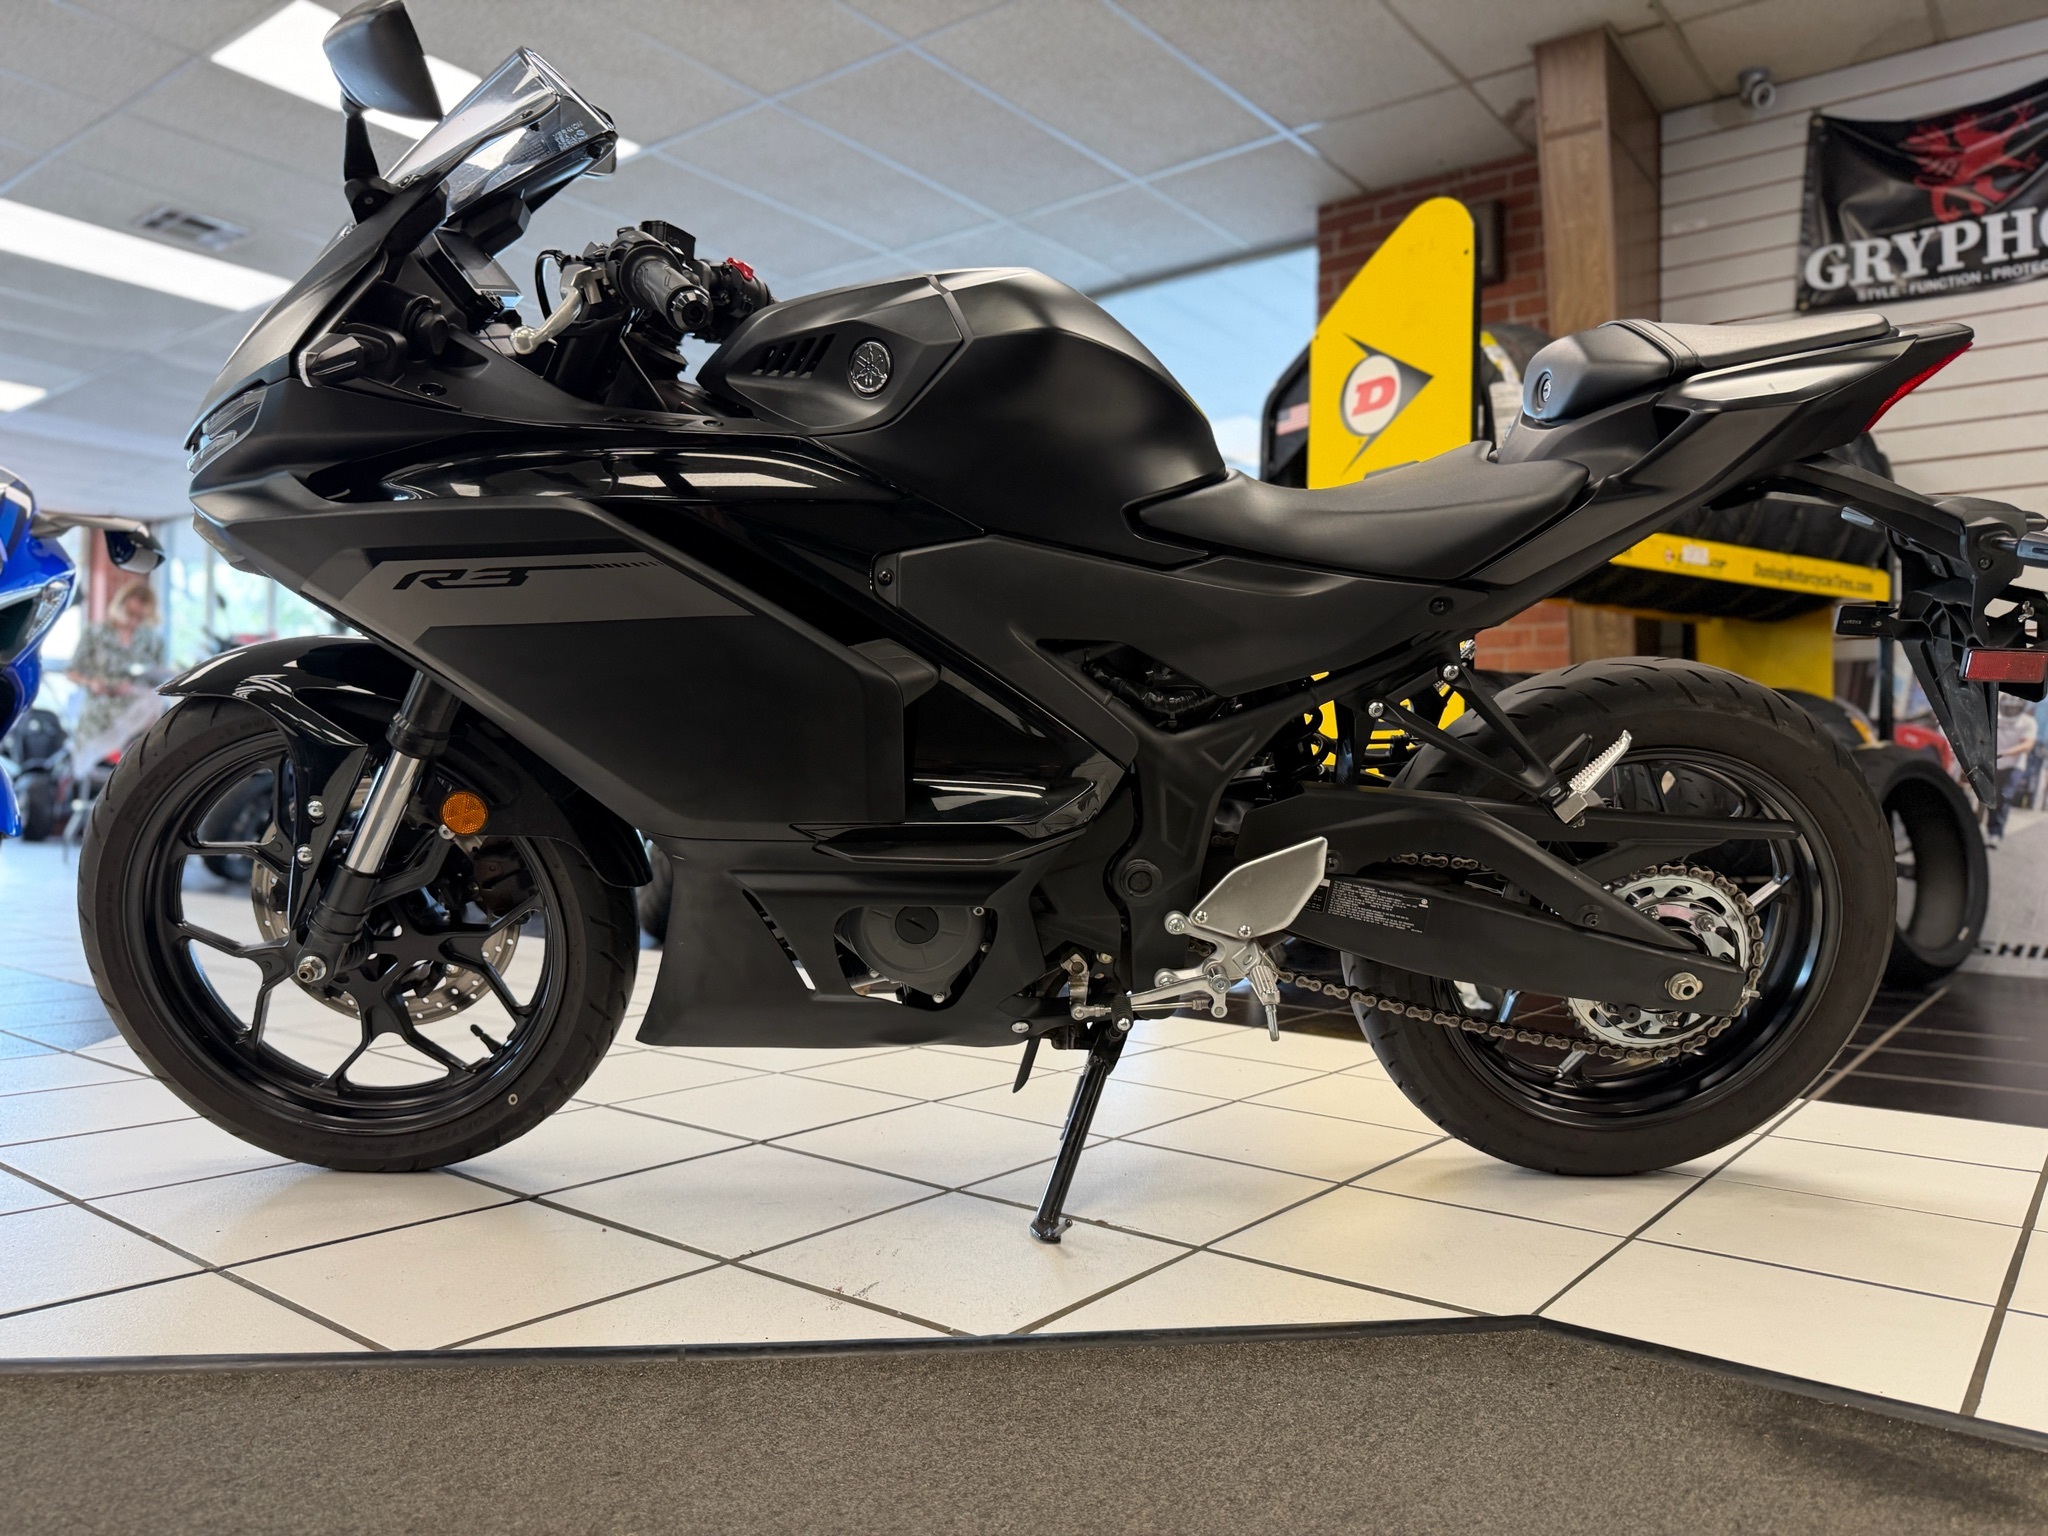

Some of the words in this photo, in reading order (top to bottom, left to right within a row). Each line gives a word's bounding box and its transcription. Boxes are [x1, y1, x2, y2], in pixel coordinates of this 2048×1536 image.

[1857, 285, 1899, 302] STYLE
[1909, 271, 1982, 295] FUNCTION
[1351, 375, 1397, 417] D
[393, 567, 530, 590] R3
[1974, 941, 2048, 960] SHI
